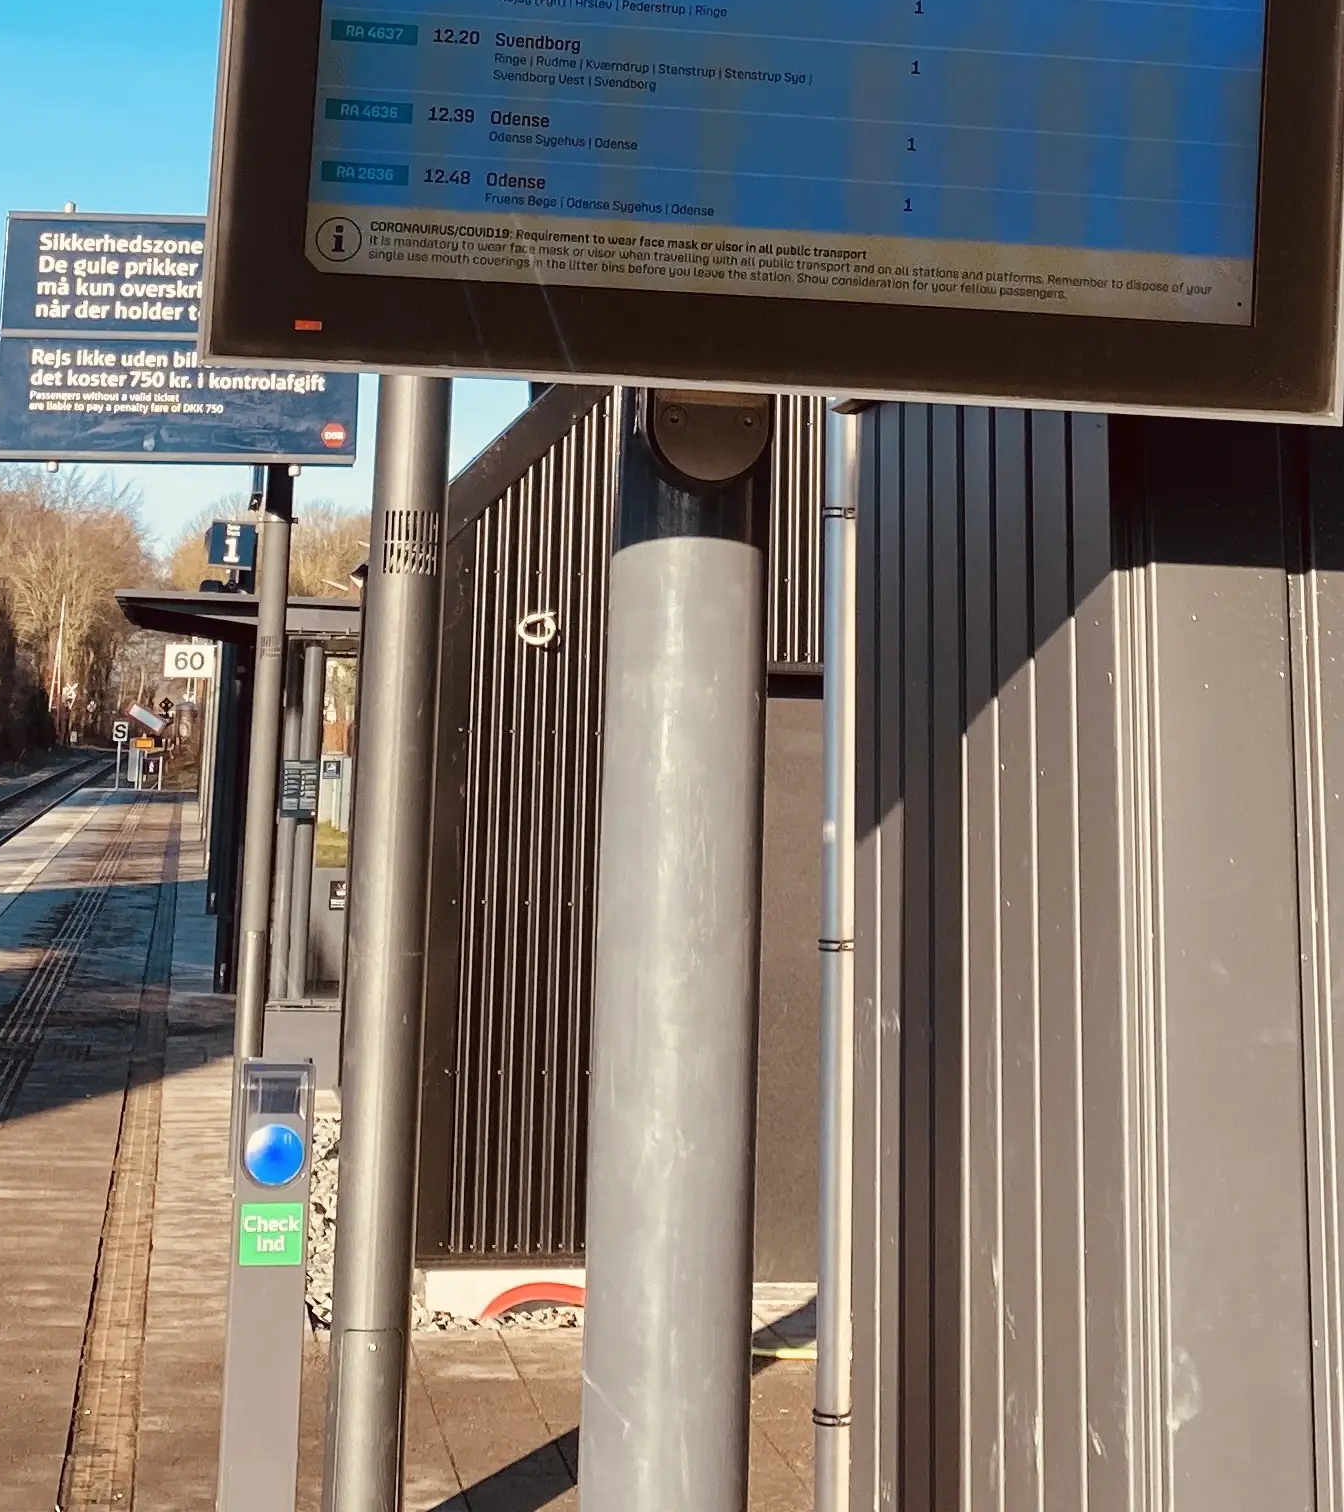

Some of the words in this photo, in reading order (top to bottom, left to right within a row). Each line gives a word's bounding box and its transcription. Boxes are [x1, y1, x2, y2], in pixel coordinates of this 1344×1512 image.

[621, 0, 685, 16] Pederstrup
[695, 4, 727, 19] Ringe
[913, 0, 924, 14] 1
[345, 24, 364, 37] RA
[367, 26, 403, 39] 4637
[431, 27, 480, 45] 12.20
[495, 31, 580, 54] Svendborg
[493, 52, 527, 66] Ringe
[536, 55, 577, 68] Rudme
[658, 62, 715, 79] Stenstrup
[724, 67, 781, 83] Stenstrup
[910, 60, 920, 75] 1
[492, 69, 556, 85] Svendborg
[558, 73, 585, 85] Vest
[594, 75, 656, 92] Svendborg
[340, 104, 359, 117] RA
[361, 105, 398, 119] 4636
[426, 106, 475, 124] 12.39
[490, 110, 550, 129] Odense
[488, 131, 532, 144] Odense
[535, 134, 586, 147] Sygehus
[594, 137, 637, 151] Odense
[906, 137, 916, 151] 1
[336, 166, 355, 178] RA
[357, 167, 394, 181] 2636
[422, 167, 471, 186] 12.48
[486, 171, 546, 191] Odense
[484, 193, 525, 206] Fruens
[566, 198, 610, 211] Odense
[612, 201, 662, 215] Sygehus
[671, 204, 714, 218] Odense
[903, 197, 913, 212] 1
[39, 232, 204, 254] Sikkerhedszone
[370, 220, 512, 238] CORONAVIRUS/COVID19:
[516, 229, 589, 244] Requirement
[607, 237, 636, 247] wear
[639, 236, 665, 249] face
[667, 239, 698, 251] mask
[714, 241, 743, 253] visor
[758, 244, 773, 255] all
[775, 245, 811, 258] public
[813, 247, 867, 262] transport
[38, 255, 67, 273] De
[73, 257, 119, 277] gule
[125, 257, 199, 279] prikker
[37, 277, 69, 295] må
[76, 278, 114, 296] kun
[35, 299, 70, 318] når
[74, 301, 110, 319] der
[115, 301, 184, 321] holder
[31, 349, 71, 368] Rejs
[121, 351, 168, 367] uden
[30, 369, 63, 386] det
[67, 370, 127, 387] koster
[130, 371, 164, 388] 750
[169, 372, 192, 388] kr.
[209, 372, 325, 394] kontrolafgift
[30, 390, 81, 402] Passengers
[82, 391, 119, 401] without
[129, 392, 151, 402] valid
[154, 393, 180, 402] ticket
[46, 401, 72, 411] liable
[86, 403, 104, 413] pay
[114, 403, 149, 414] penalty
[151, 403, 169, 412] fare
[183, 404, 203, 413] DKK
[205, 404, 224, 414] 750
[223, 538, 240, 563] 1
[175, 651, 205, 670] 60
[115, 724, 127, 739] S
[243, 1215, 300, 1232] Check
